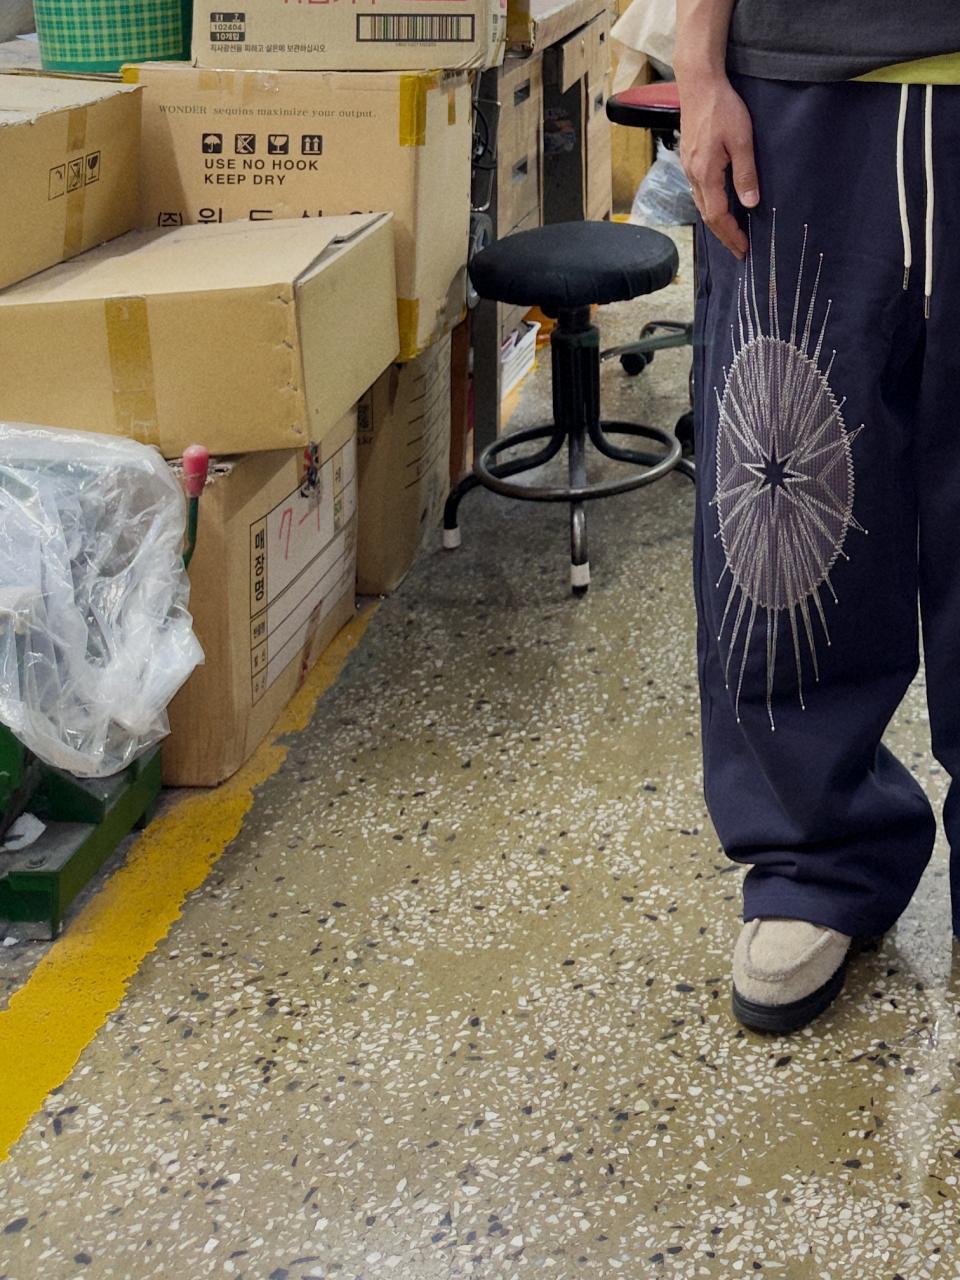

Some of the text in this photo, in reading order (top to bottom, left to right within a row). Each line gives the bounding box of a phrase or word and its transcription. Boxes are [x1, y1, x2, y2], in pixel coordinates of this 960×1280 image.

[159, 105, 207, 115] WONDER
[257, 108, 309, 117] maximize
[204, 158, 319, 171] USE NO HOOK
[204, 173, 286, 185] KEEP DRY
